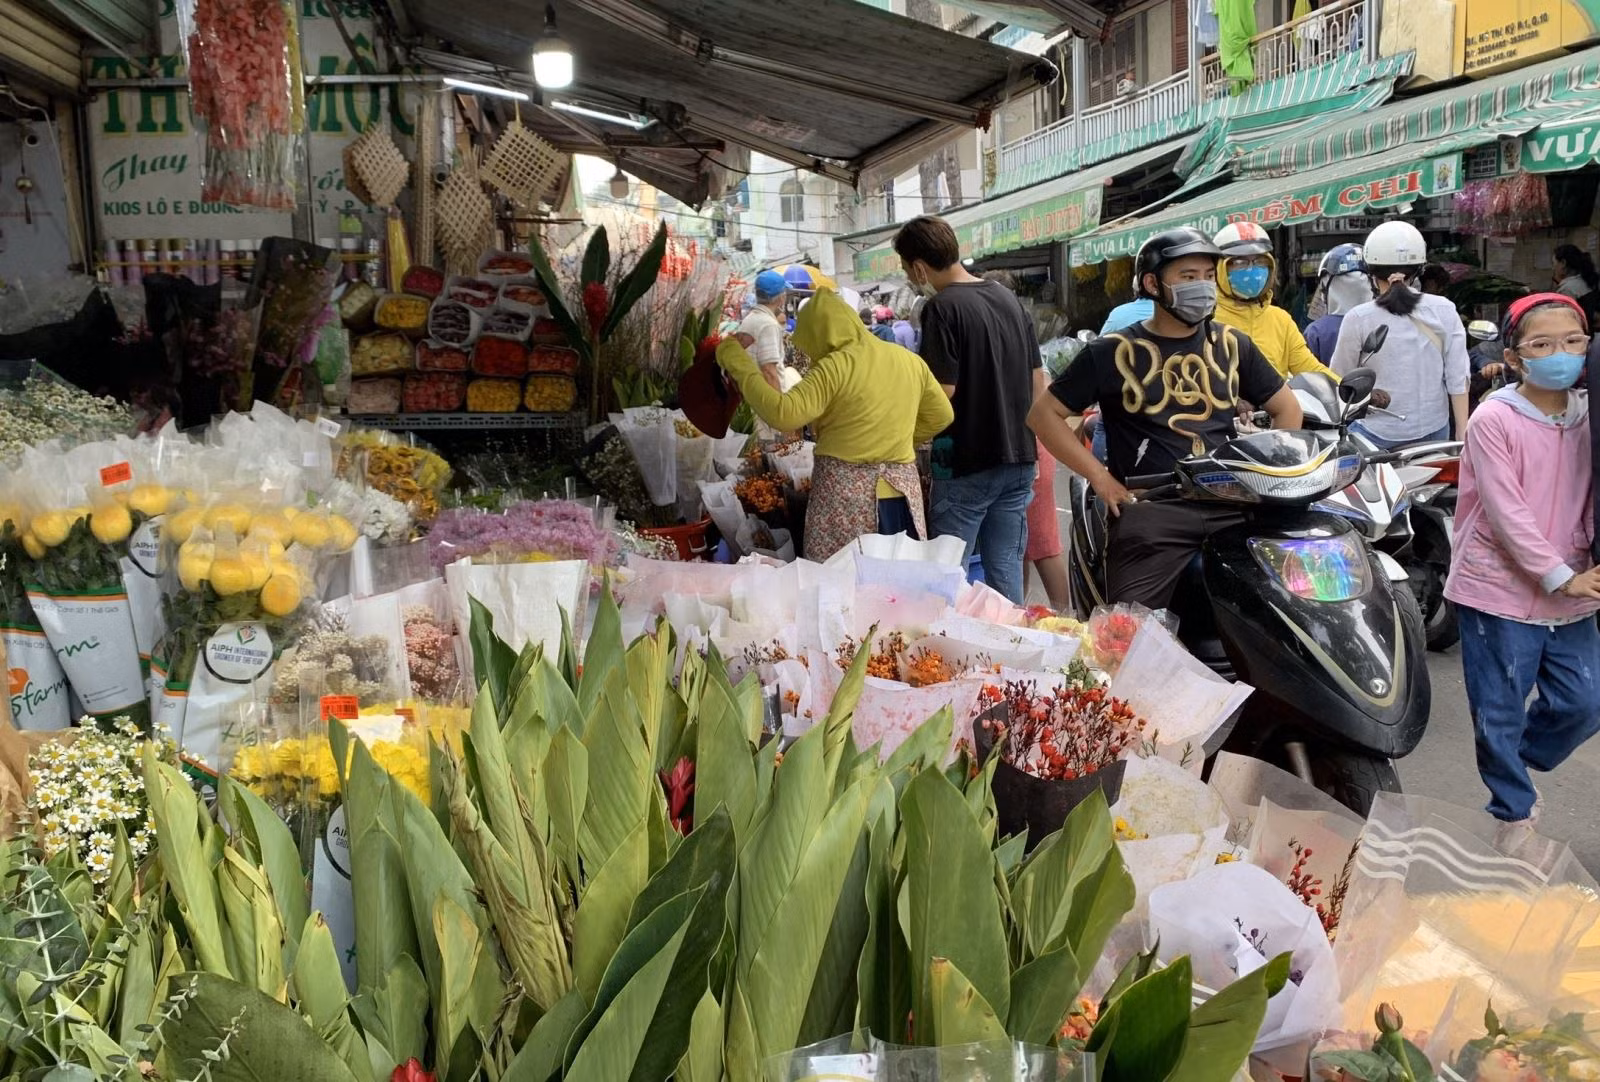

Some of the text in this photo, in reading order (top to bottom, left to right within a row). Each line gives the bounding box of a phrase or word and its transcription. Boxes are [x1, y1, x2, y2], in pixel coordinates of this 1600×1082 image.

[102, 153, 188, 193] Thay
[1338, 170, 1422, 208] CHI
[104, 201, 141, 216] KIOS
[147, 198, 167, 215] LÔ
[173, 201, 183, 214] E
[1119, 232, 1136, 251] LÁ
[211, 643, 234, 653] AIPH
